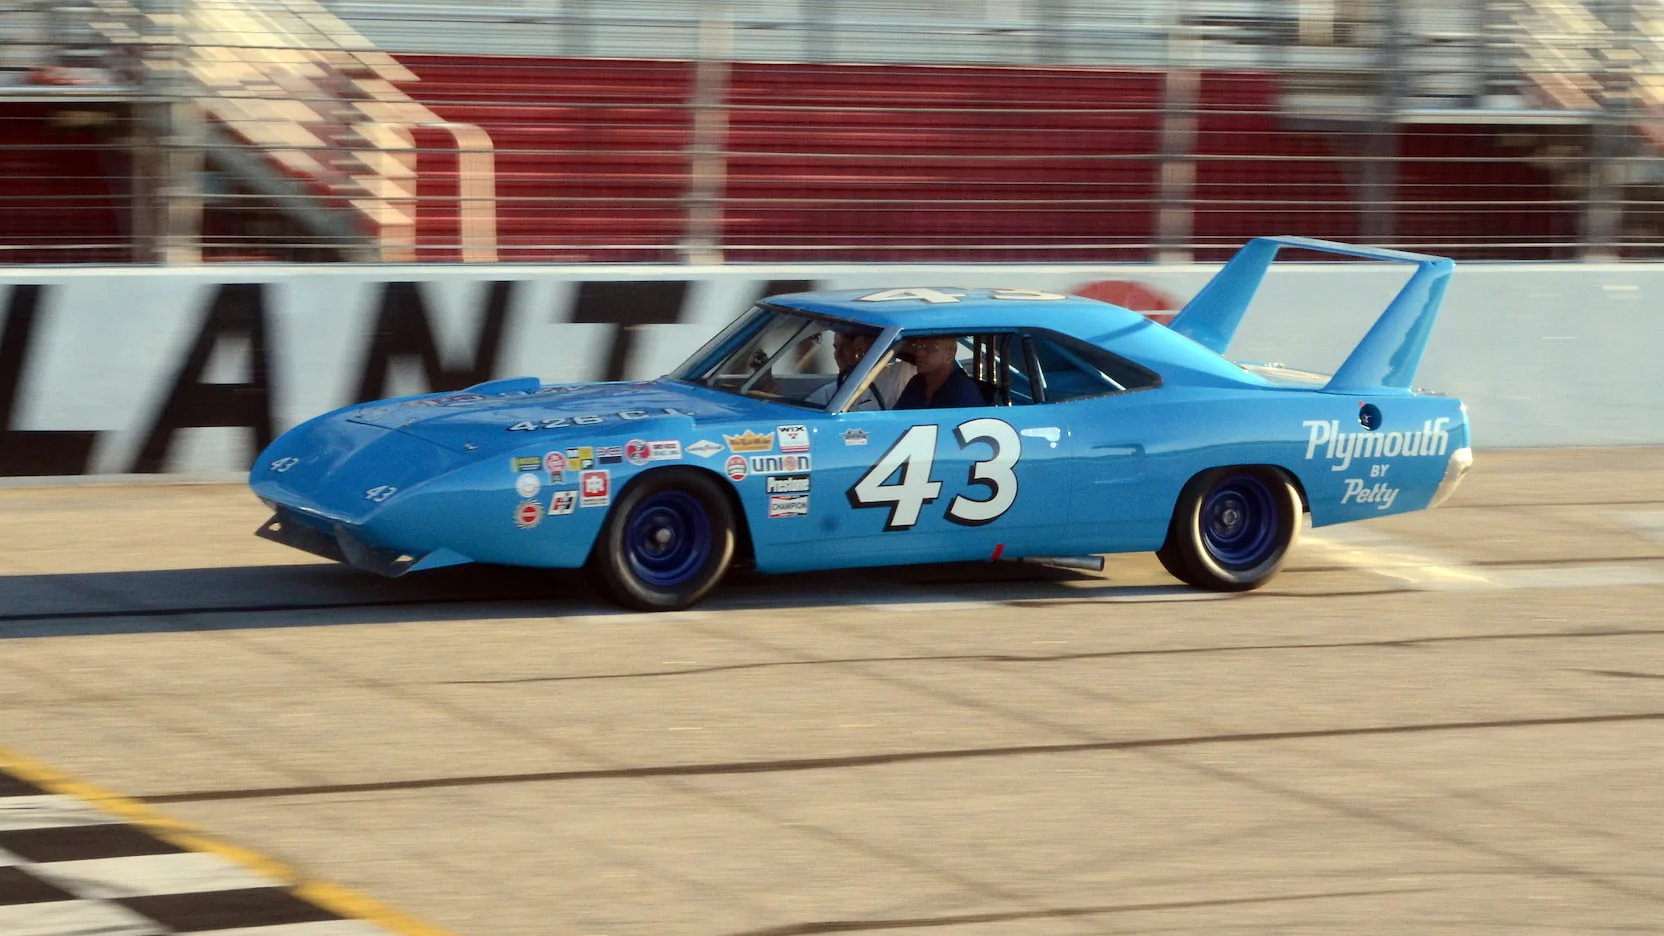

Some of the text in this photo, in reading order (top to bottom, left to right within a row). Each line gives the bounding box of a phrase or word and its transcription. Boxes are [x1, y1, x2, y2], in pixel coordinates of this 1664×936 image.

[507, 415, 604, 431] 426
[1303, 417, 1450, 471] Plymouth
[270, 457, 299, 472] 43
[1370, 464, 1389, 477] BY
[846, 417, 1022, 532] 43
[365, 485, 398, 502] 43
[1340, 478, 1400, 510] Petty
[772, 502, 807, 511] CHAMPION
